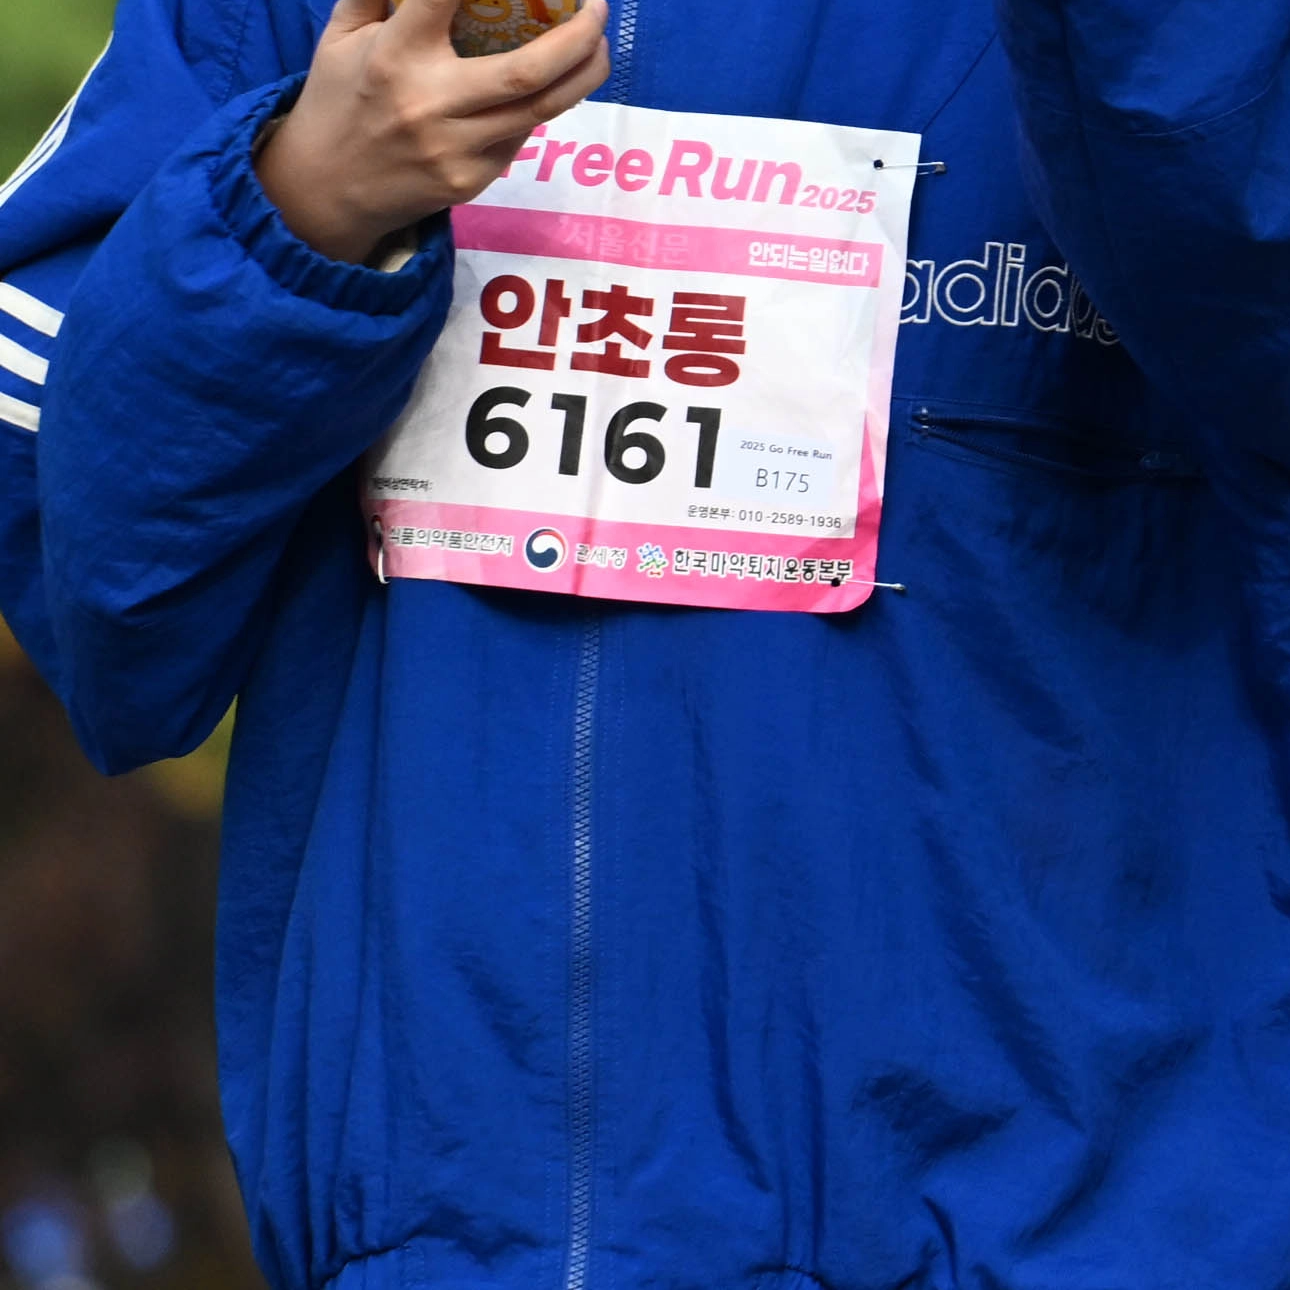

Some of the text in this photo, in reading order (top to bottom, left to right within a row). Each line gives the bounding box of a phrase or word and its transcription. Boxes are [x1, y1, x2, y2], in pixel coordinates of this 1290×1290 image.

[799, 184, 877, 214] 2025
[562, 221, 690, 265] 서울신문
[479, 274, 747, 388] 안초롱
[465, 386, 723, 490] 6161
[740, 439, 833, 461] 2025 Go Free Run
[755, 467, 810, 494] B175
[674, 549, 852, 583] 한국마약퇴치운동본부
